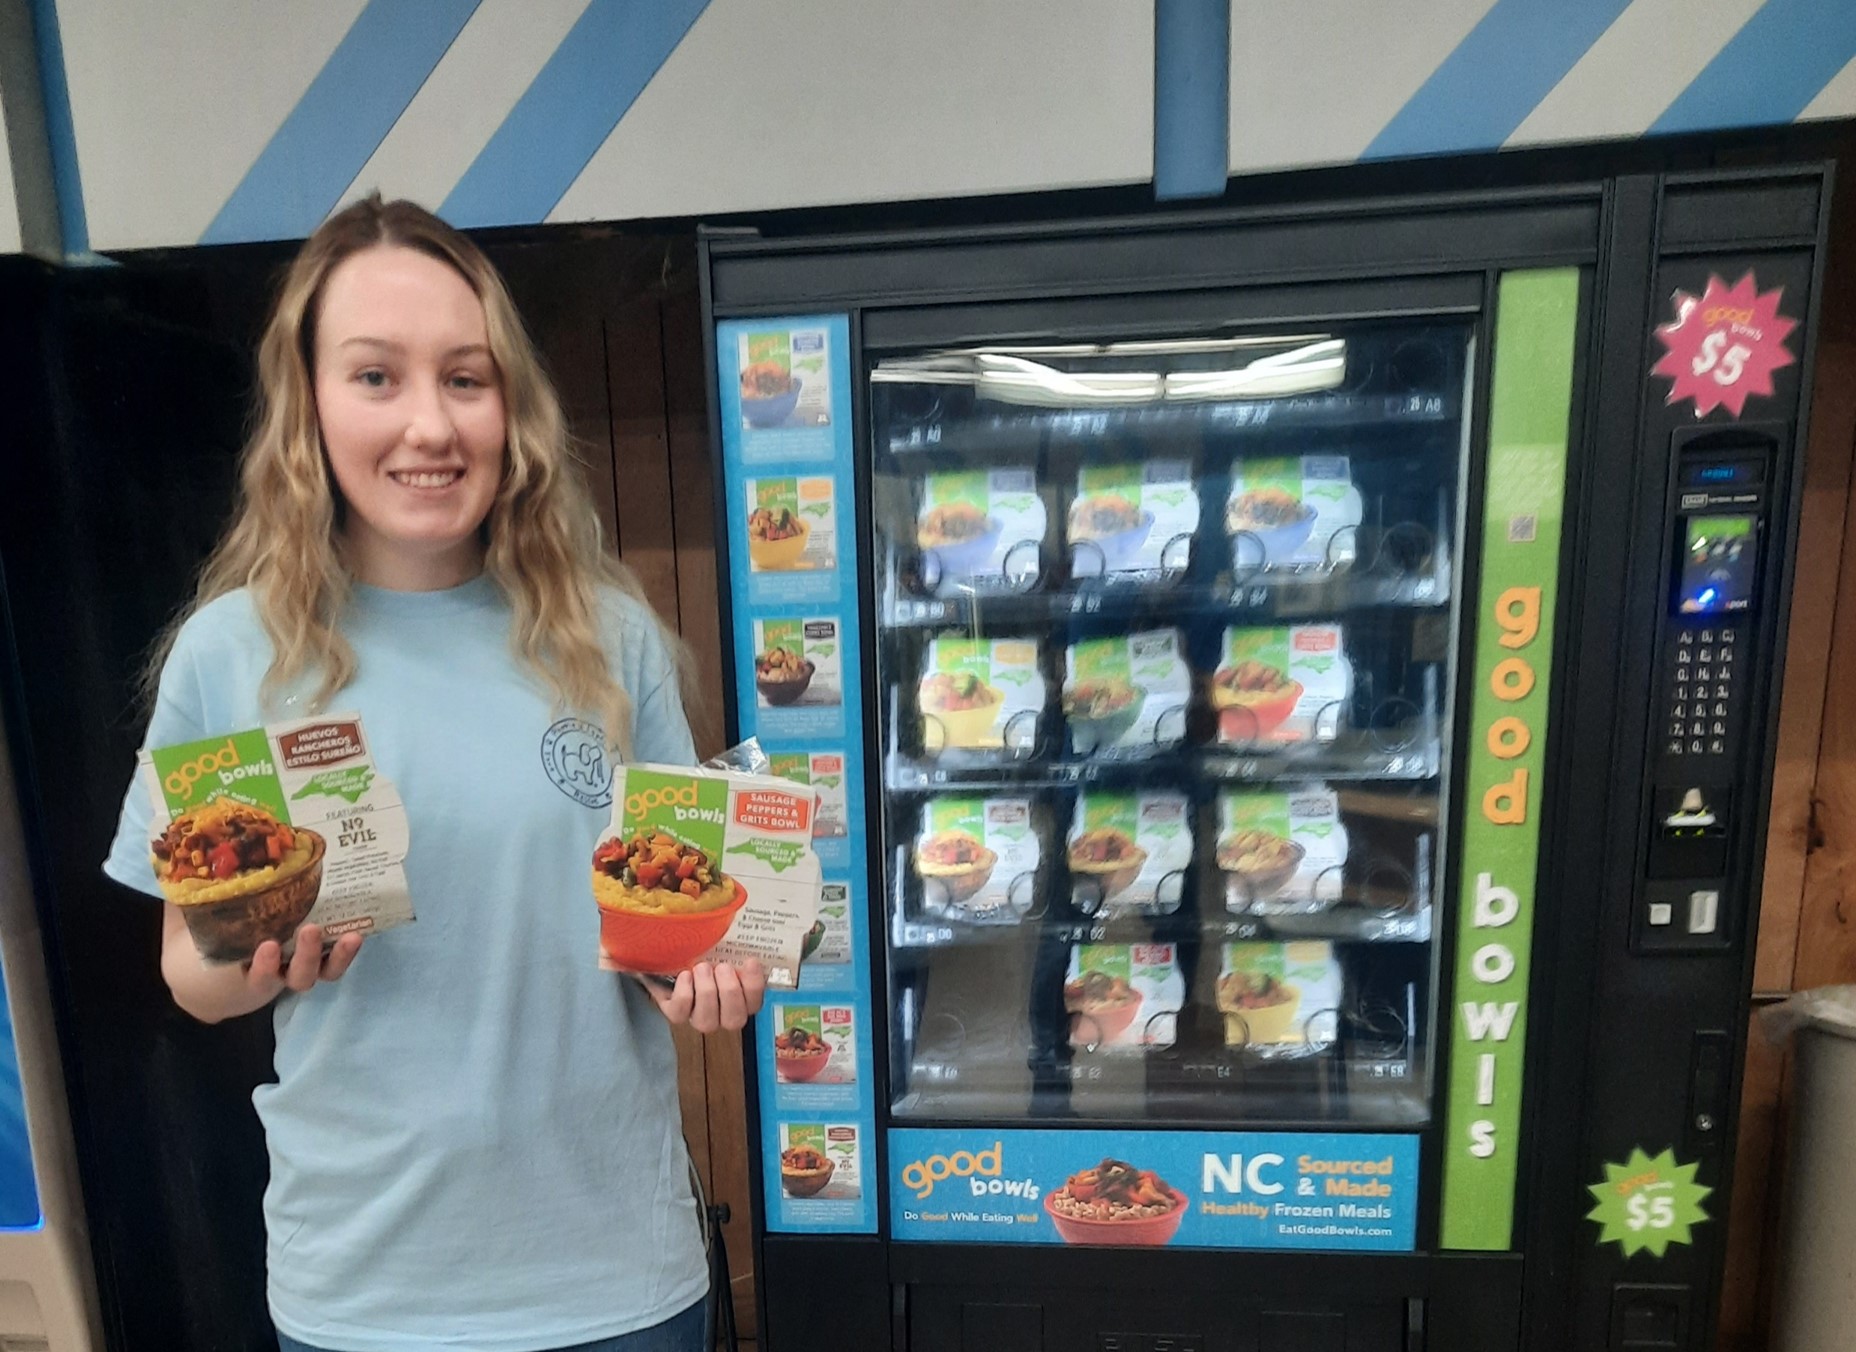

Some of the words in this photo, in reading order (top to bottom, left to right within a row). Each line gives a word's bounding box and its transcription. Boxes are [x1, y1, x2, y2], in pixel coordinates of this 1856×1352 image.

[1704, 307, 1755, 327] good
[1692, 330, 1752, 386] $5
[1482, 585, 1542, 826] good
[297, 726, 338, 742] HUEVOS
[291, 735, 351, 755] RANCHEROS
[164, 738, 240, 801] good
[218, 759, 274, 785] bowls
[206, 788, 229, 803] while
[231, 791, 258, 805] eating
[625, 780, 698, 821] good
[751, 793, 797, 806] SAUSAGE
[326, 803, 374, 820] FEATURING
[674, 805, 725, 824] bowls
[746, 803, 788, 817] PEPPERS
[791, 808, 798, 817] &
[740, 814, 768, 825] GRITS
[771, 819, 800, 829] BOWL
[337, 828, 377, 848] EVIL
[657, 824, 678, 838] while
[751, 839, 781, 848] LOCALLY
[326, 918, 373, 935] Vegetarian
[938, 928, 952, 940] D0
[1459, 872, 1519, 1158] bowls
[1218, 1066, 1231, 1078] E4
[1390, 1064, 1404, 1077] E8
[902, 1141, 1002, 1199] good
[1203, 1153, 1285, 1195] NC
[1297, 1155, 1393, 1175] Sourced
[969, 1176, 1040, 1200] bowls
[1297, 1177, 1316, 1196] &
[1325, 1178, 1392, 1197] Made
[904, 1211, 919, 1220] Do
[921, 1211, 948, 1221] Good
[951, 1212, 980, 1222] While
[982, 1213, 1014, 1225] Eating
[1016, 1214, 1038, 1223] Well
[1202, 1201, 1269, 1219] Healthy
[1275, 1203, 1334, 1217] Frozen
[1338, 1203, 1392, 1218] Meals
[1626, 1193, 1675, 1231] $5
[1279, 1224, 1392, 1236] EatGoodBowls.com
